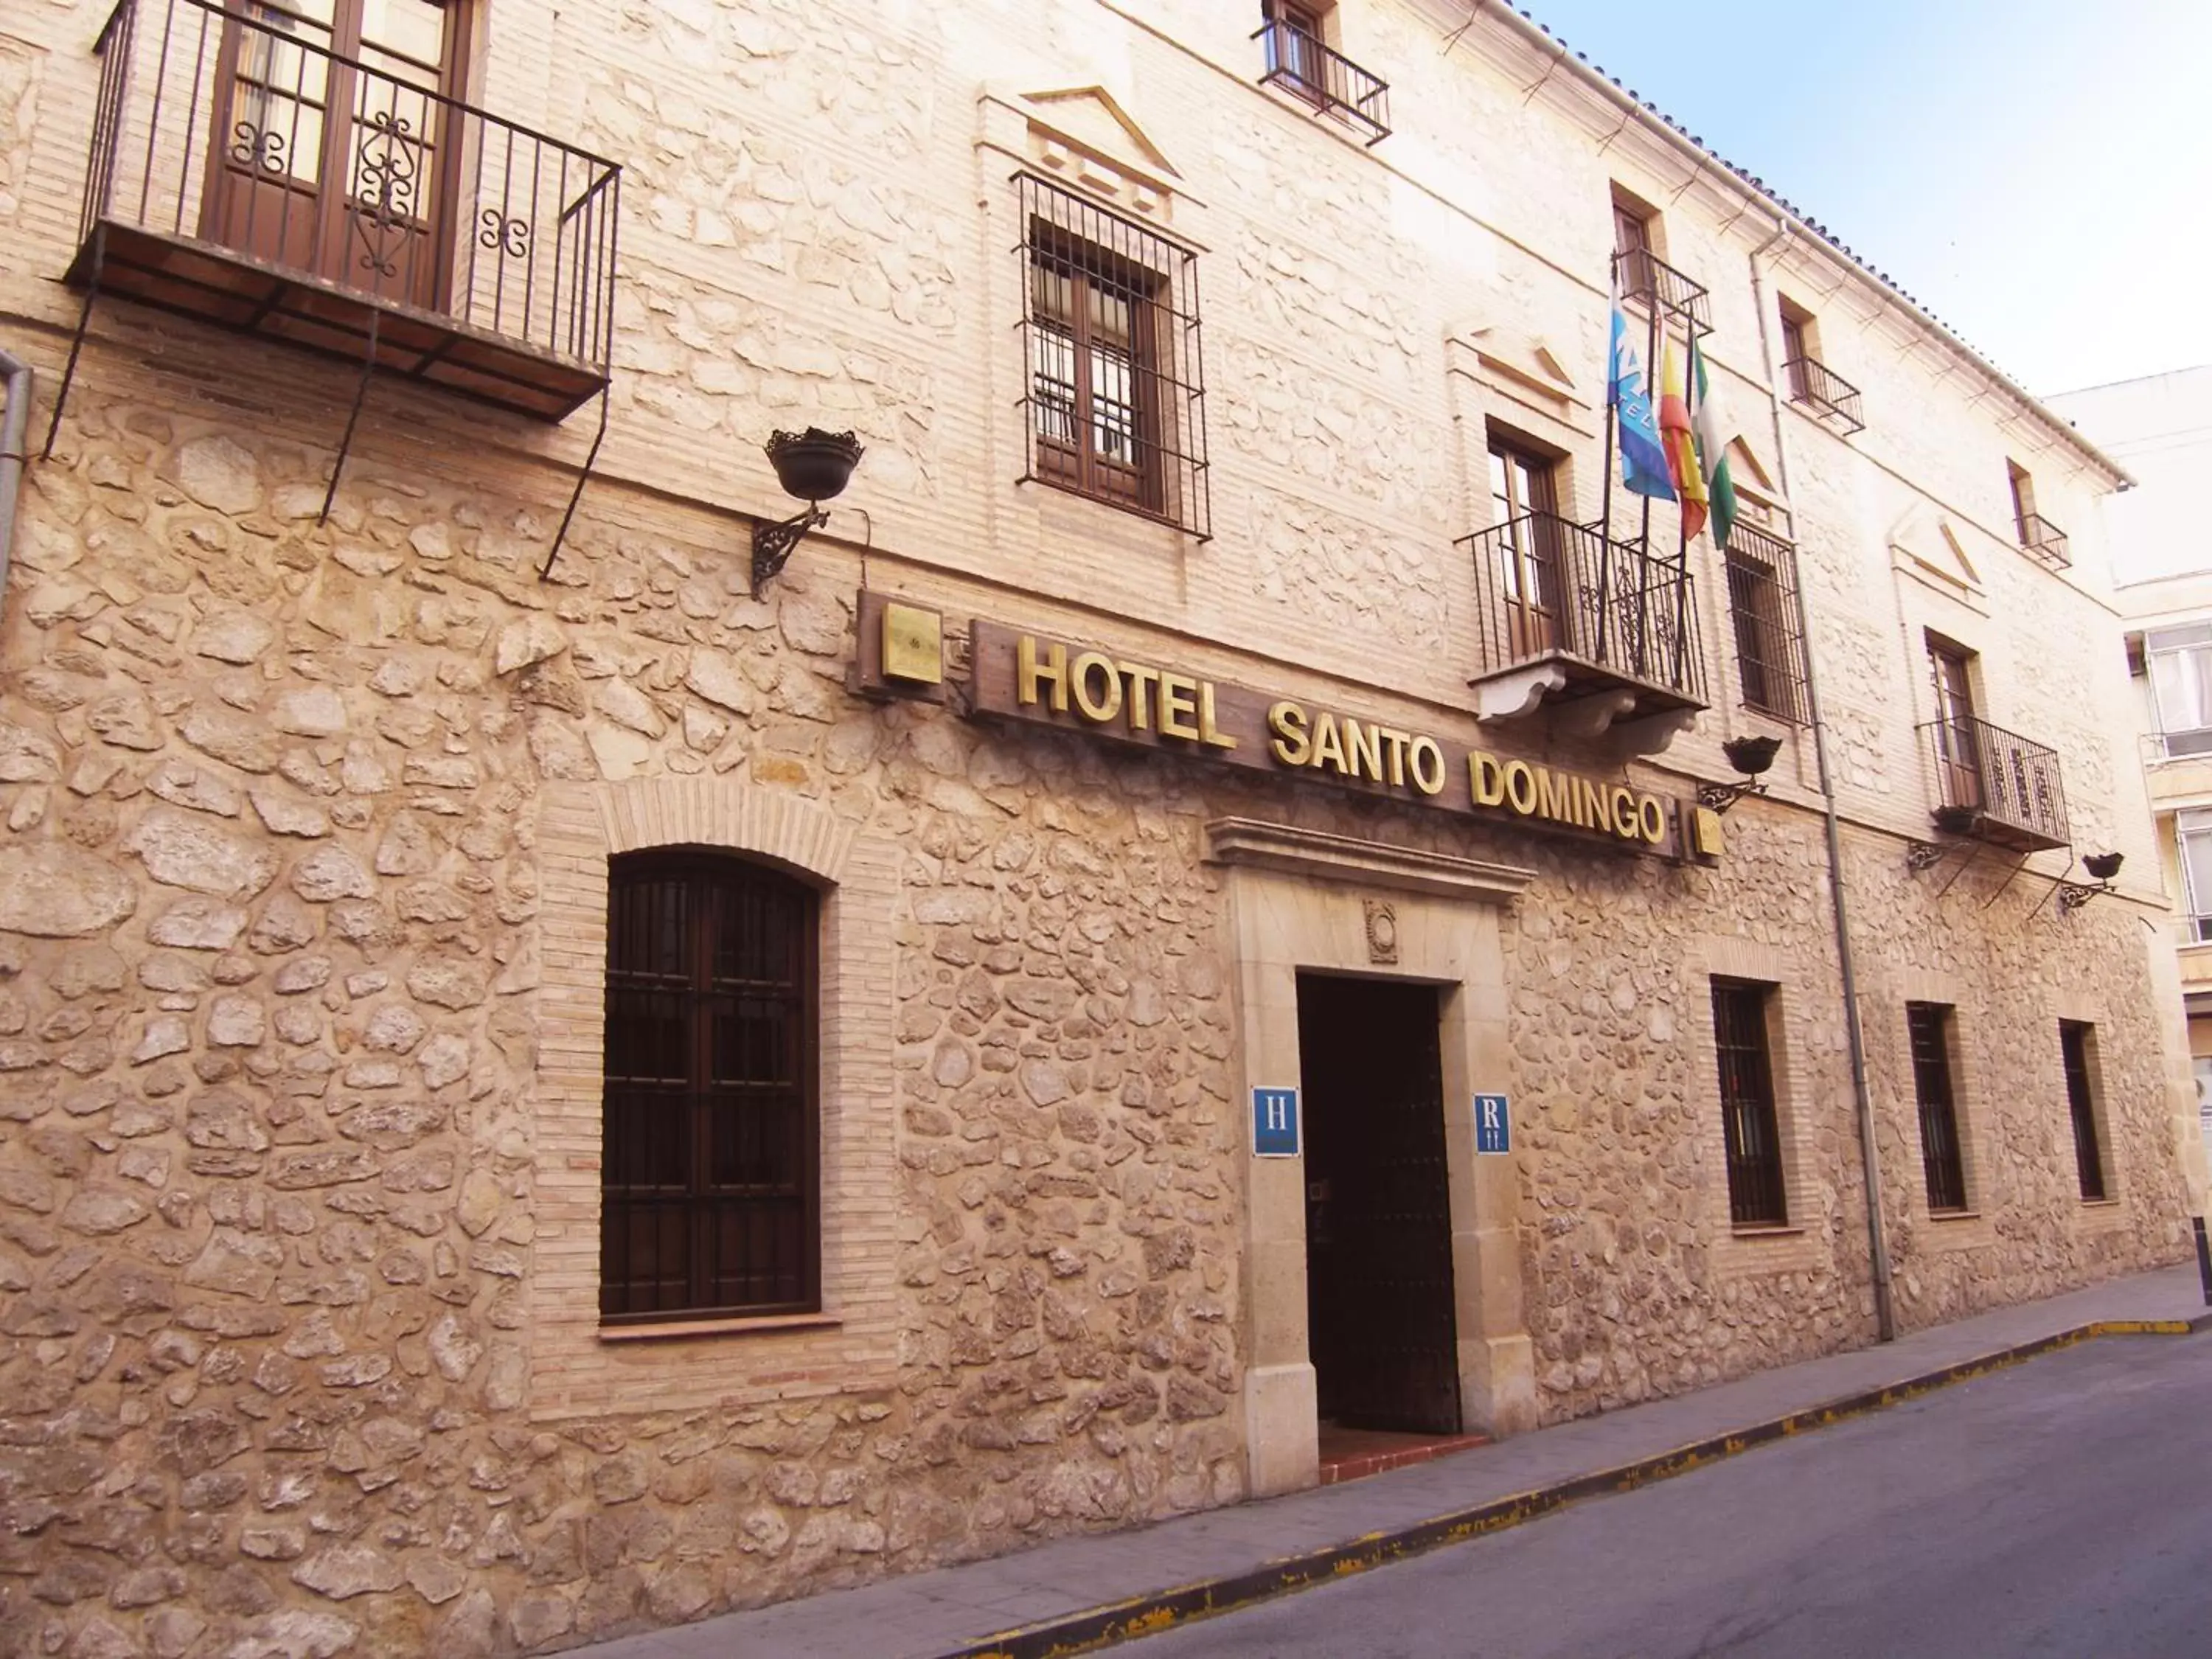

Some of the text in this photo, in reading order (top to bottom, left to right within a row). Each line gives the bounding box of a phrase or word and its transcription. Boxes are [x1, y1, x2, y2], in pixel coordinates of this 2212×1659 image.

[1017, 636, 1665, 844] HOTEL SANTO DOMINGO
[1266, 1096, 1287, 1130] H
[1482, 1098, 1500, 1128] R
